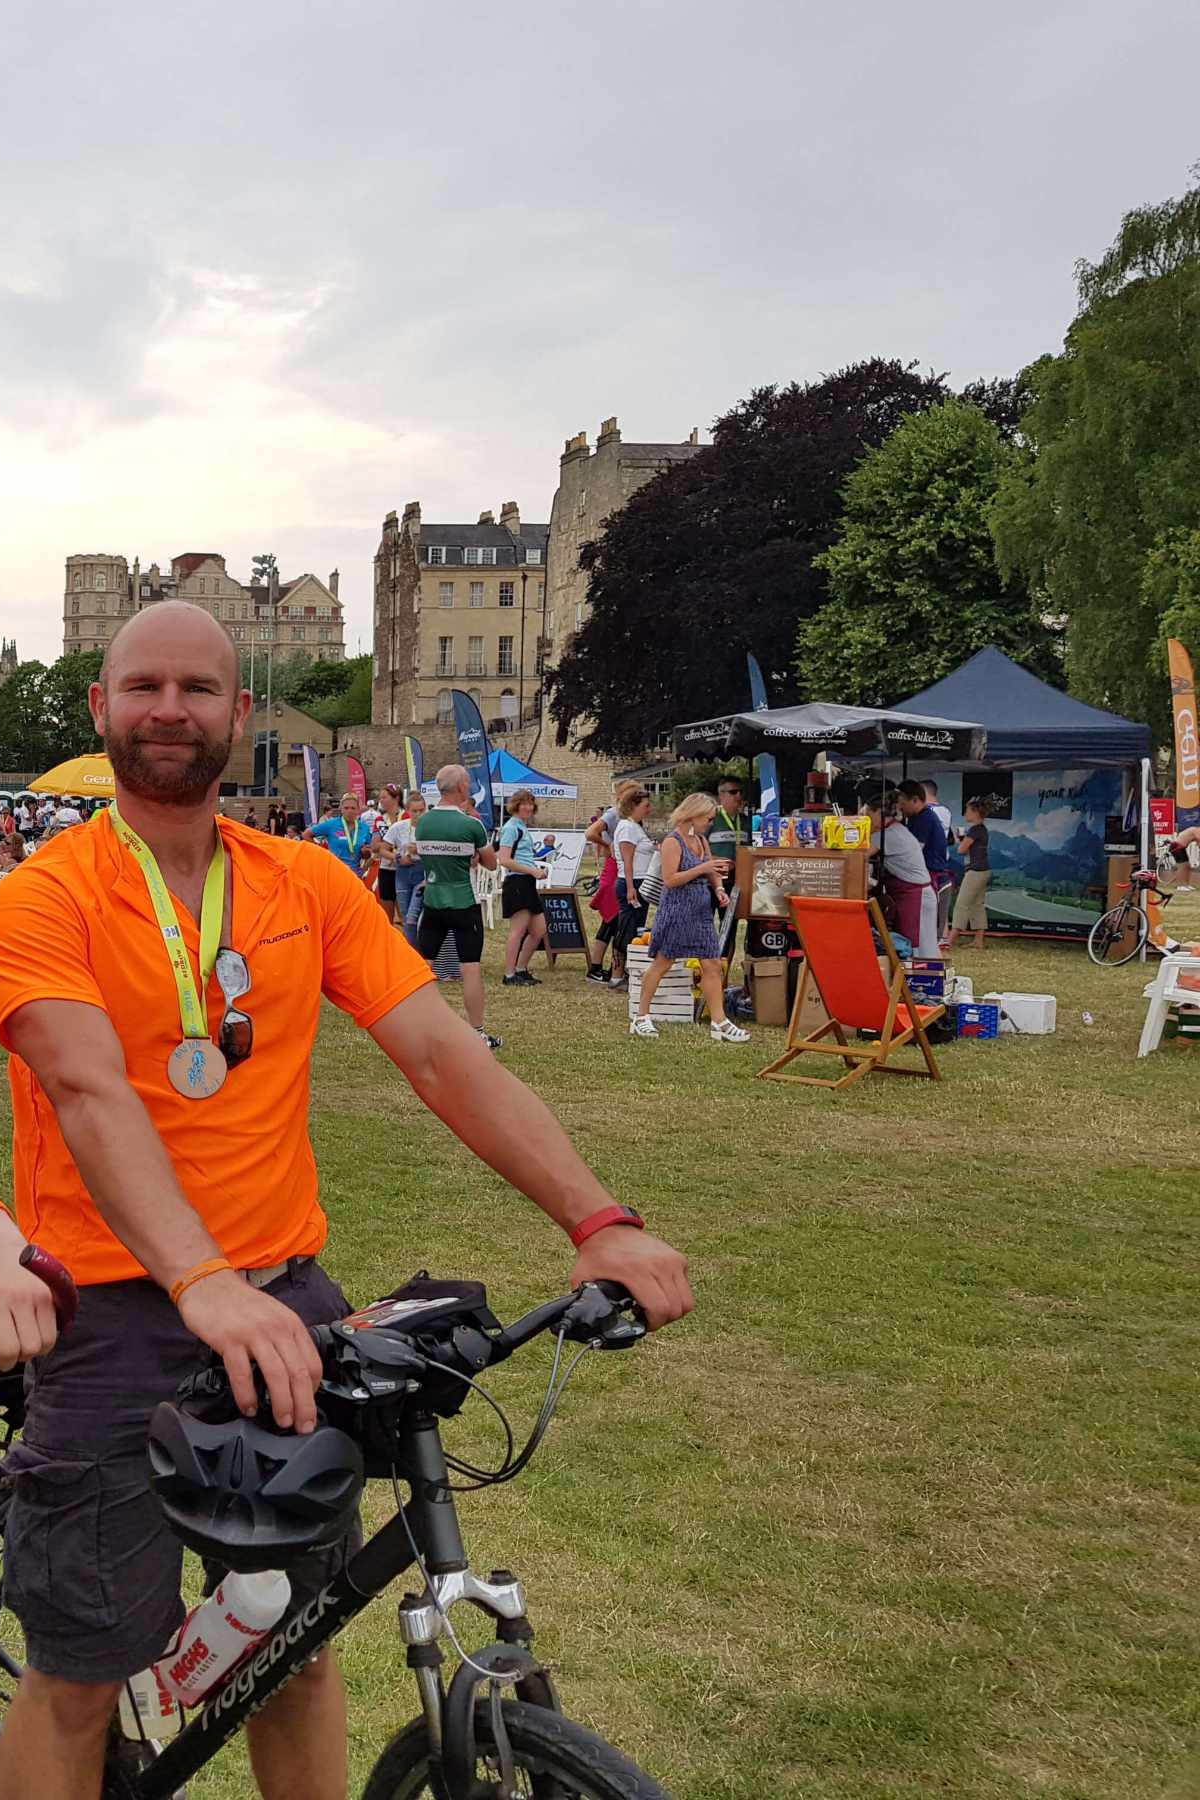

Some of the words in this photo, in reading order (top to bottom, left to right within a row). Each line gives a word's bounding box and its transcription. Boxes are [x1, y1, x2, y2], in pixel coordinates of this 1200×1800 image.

[764, 859, 793, 869] Coffee
[796, 859, 835, 870] Specials
[545, 899, 569, 909] ICED
[547, 922, 580, 933] COFFEE
[764, 934, 785, 946] GB
[201, 1580, 342, 1732] ridgeback
